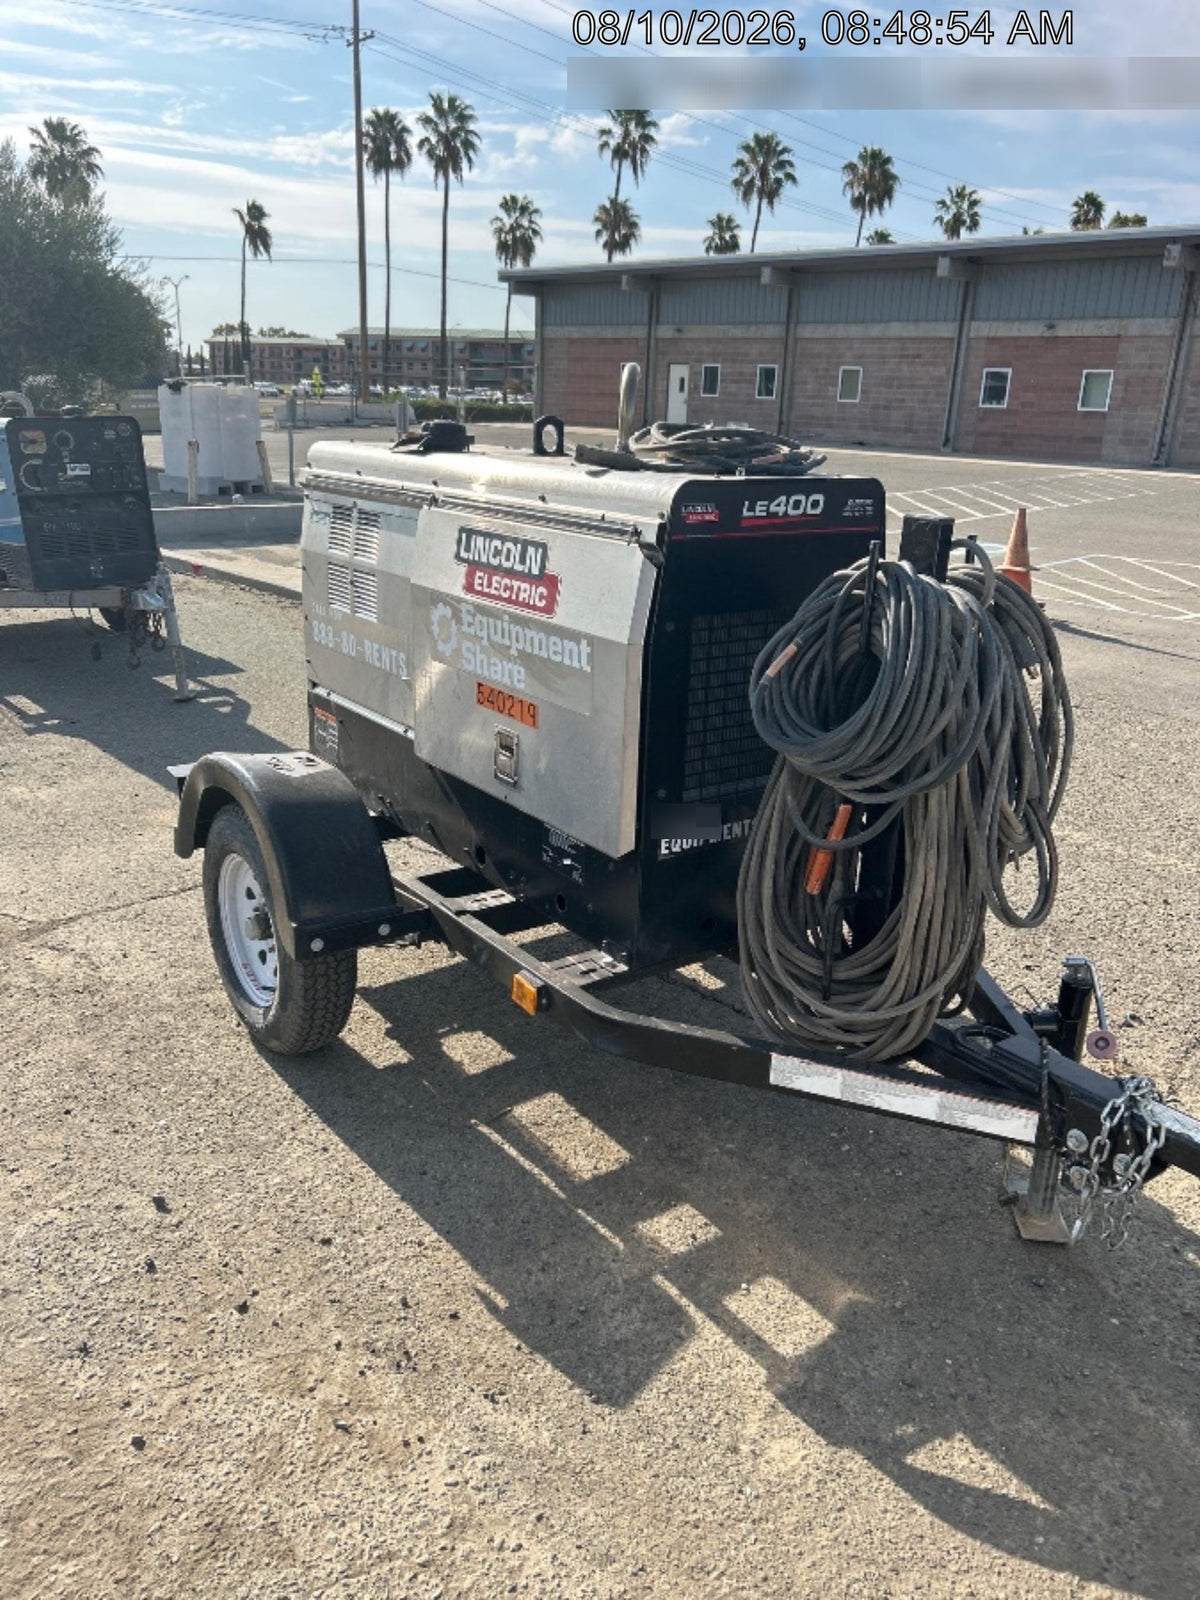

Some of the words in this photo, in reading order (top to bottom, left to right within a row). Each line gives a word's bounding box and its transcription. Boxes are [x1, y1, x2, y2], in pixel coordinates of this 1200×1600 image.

[742, 493, 825, 517] LE400
[459, 532, 544, 576] LINCOLN
[473, 570, 548, 608] ELECTRIC
[460, 602, 592, 673] Equipment
[461, 640, 526, 690] Share
[476, 681, 537, 728] 540219
